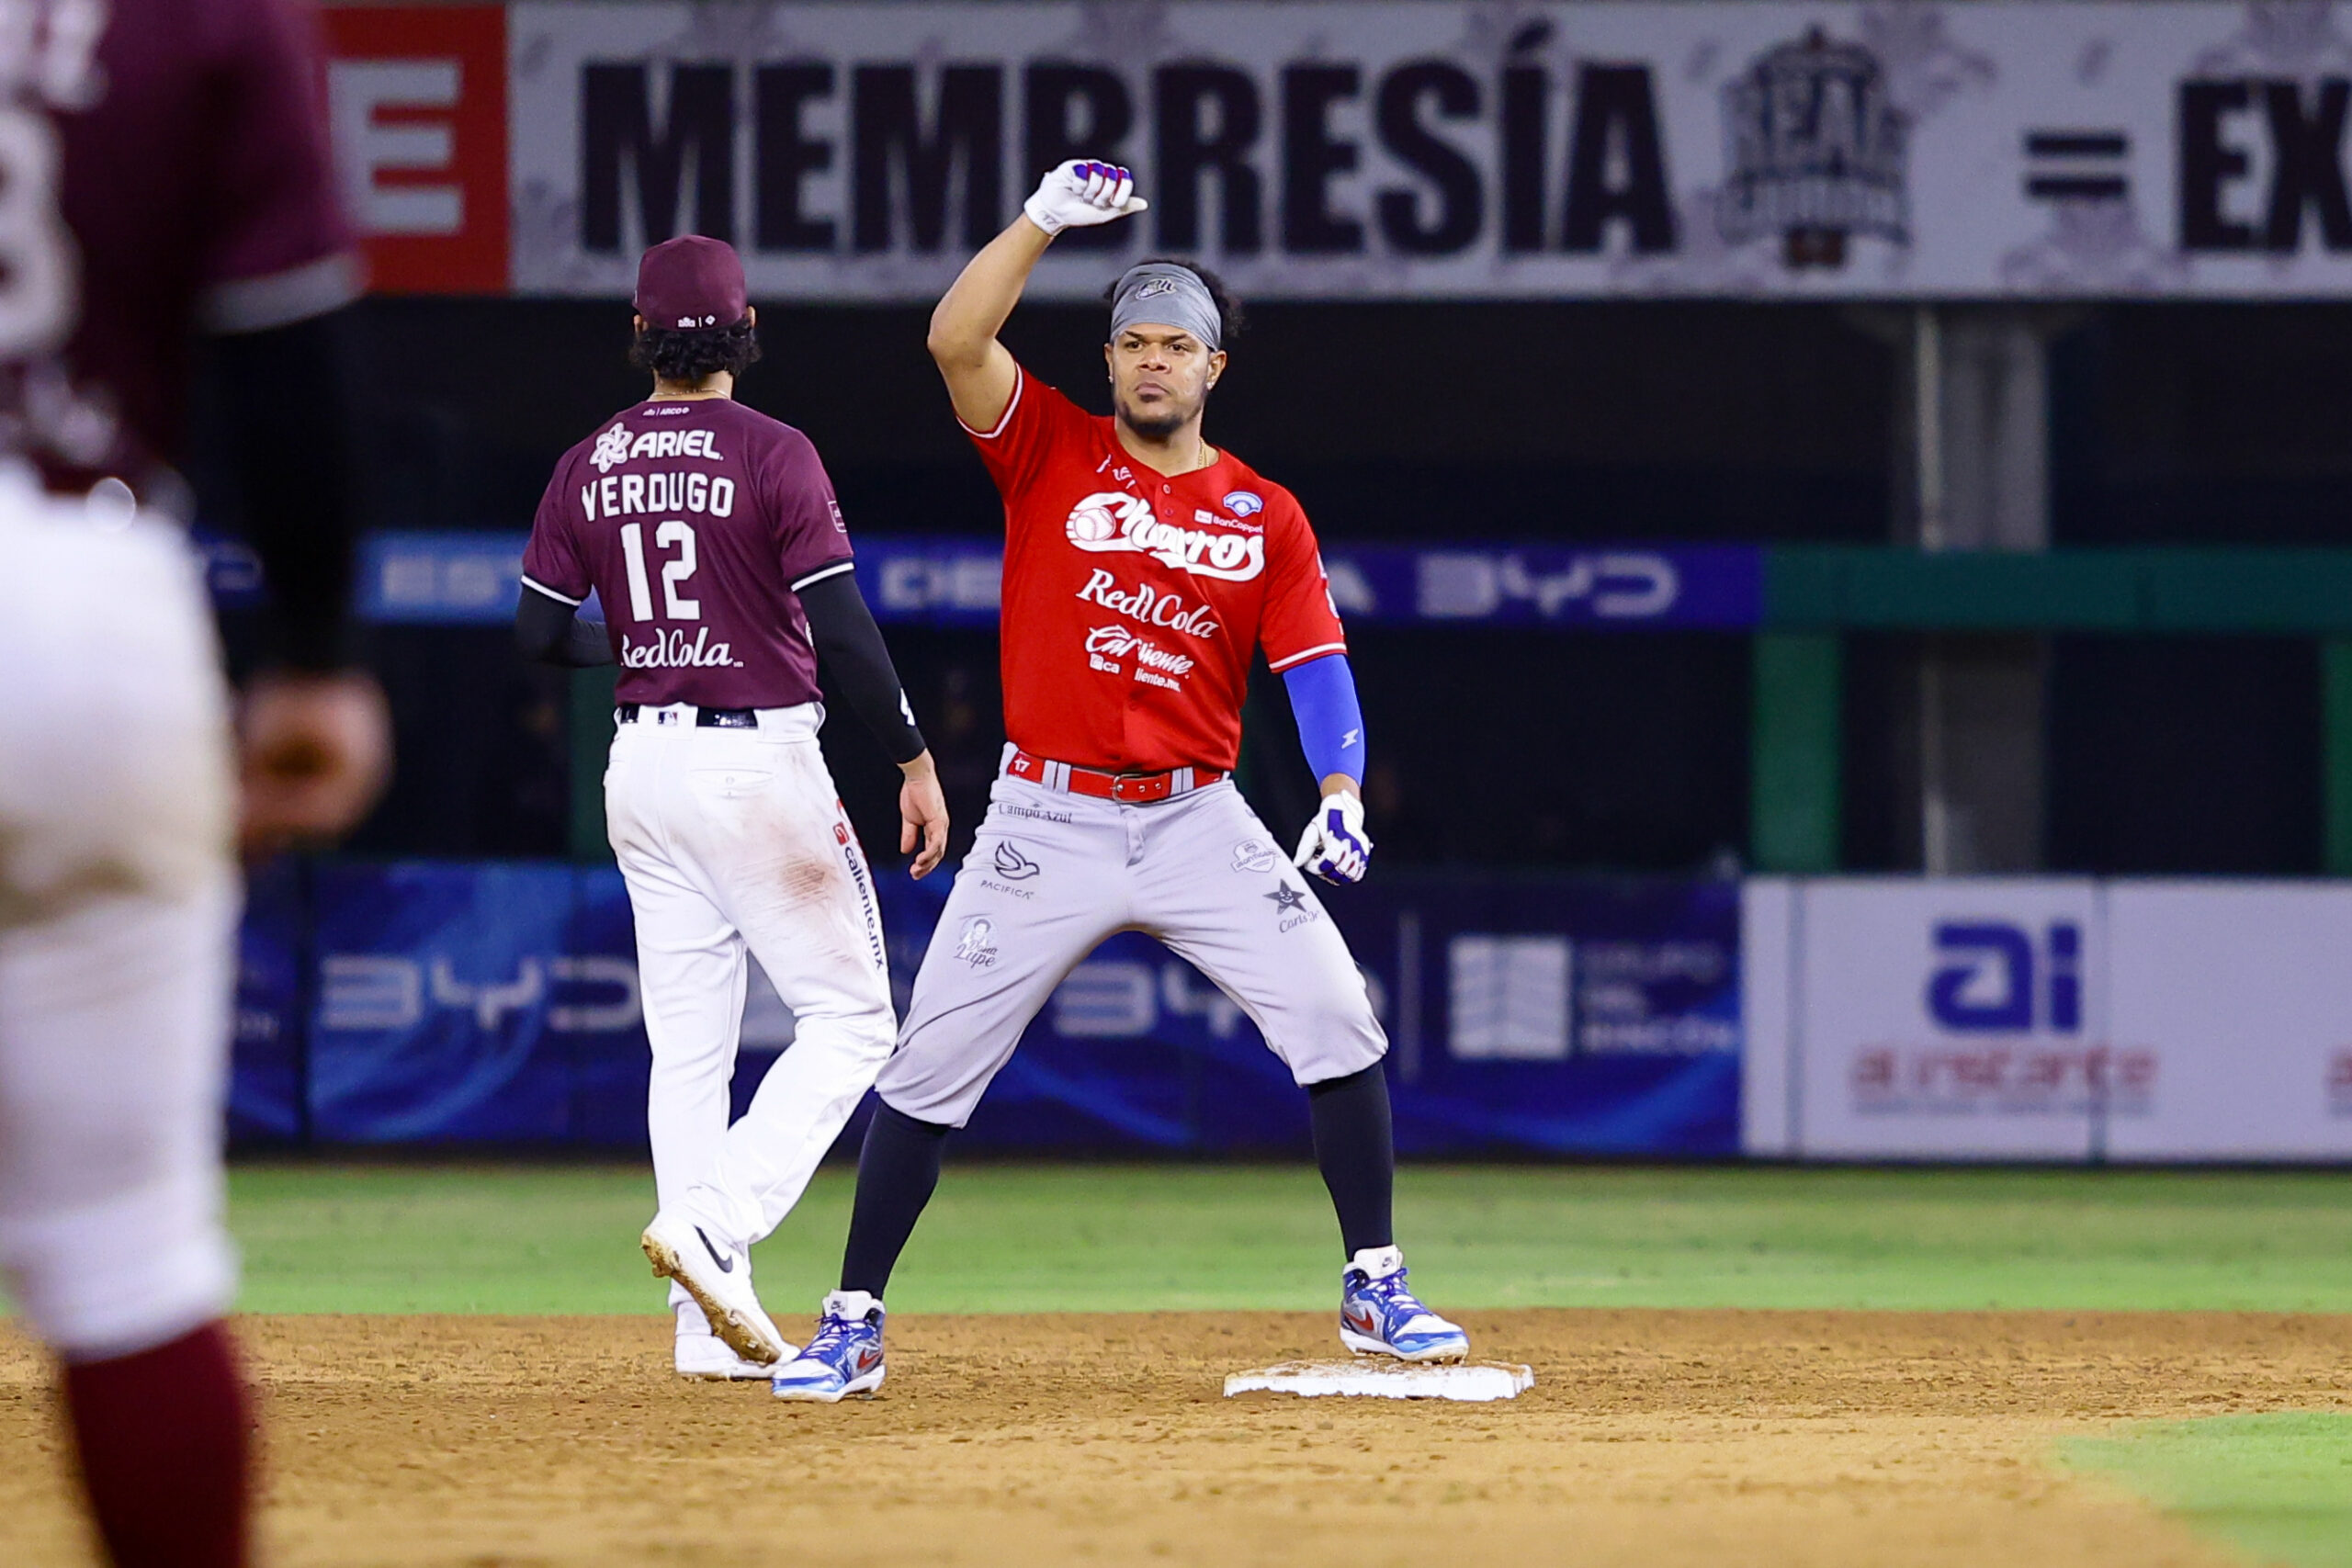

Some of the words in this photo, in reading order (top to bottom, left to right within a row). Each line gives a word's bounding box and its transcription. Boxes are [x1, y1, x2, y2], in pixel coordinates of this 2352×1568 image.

[581, 18, 1677, 255] MEMBRESÍA
[629, 430, 724, 461] ARIEL
[581, 471, 735, 522] VERDUGO
[1066, 491, 1266, 582] Charros
[620, 520, 701, 623] 12
[1014, 757, 1031, 773] 17
[844, 846, 876, 970] caliente.mx
[980, 879, 1030, 900] PACIFICA
[953, 943, 996, 969] Lupe
